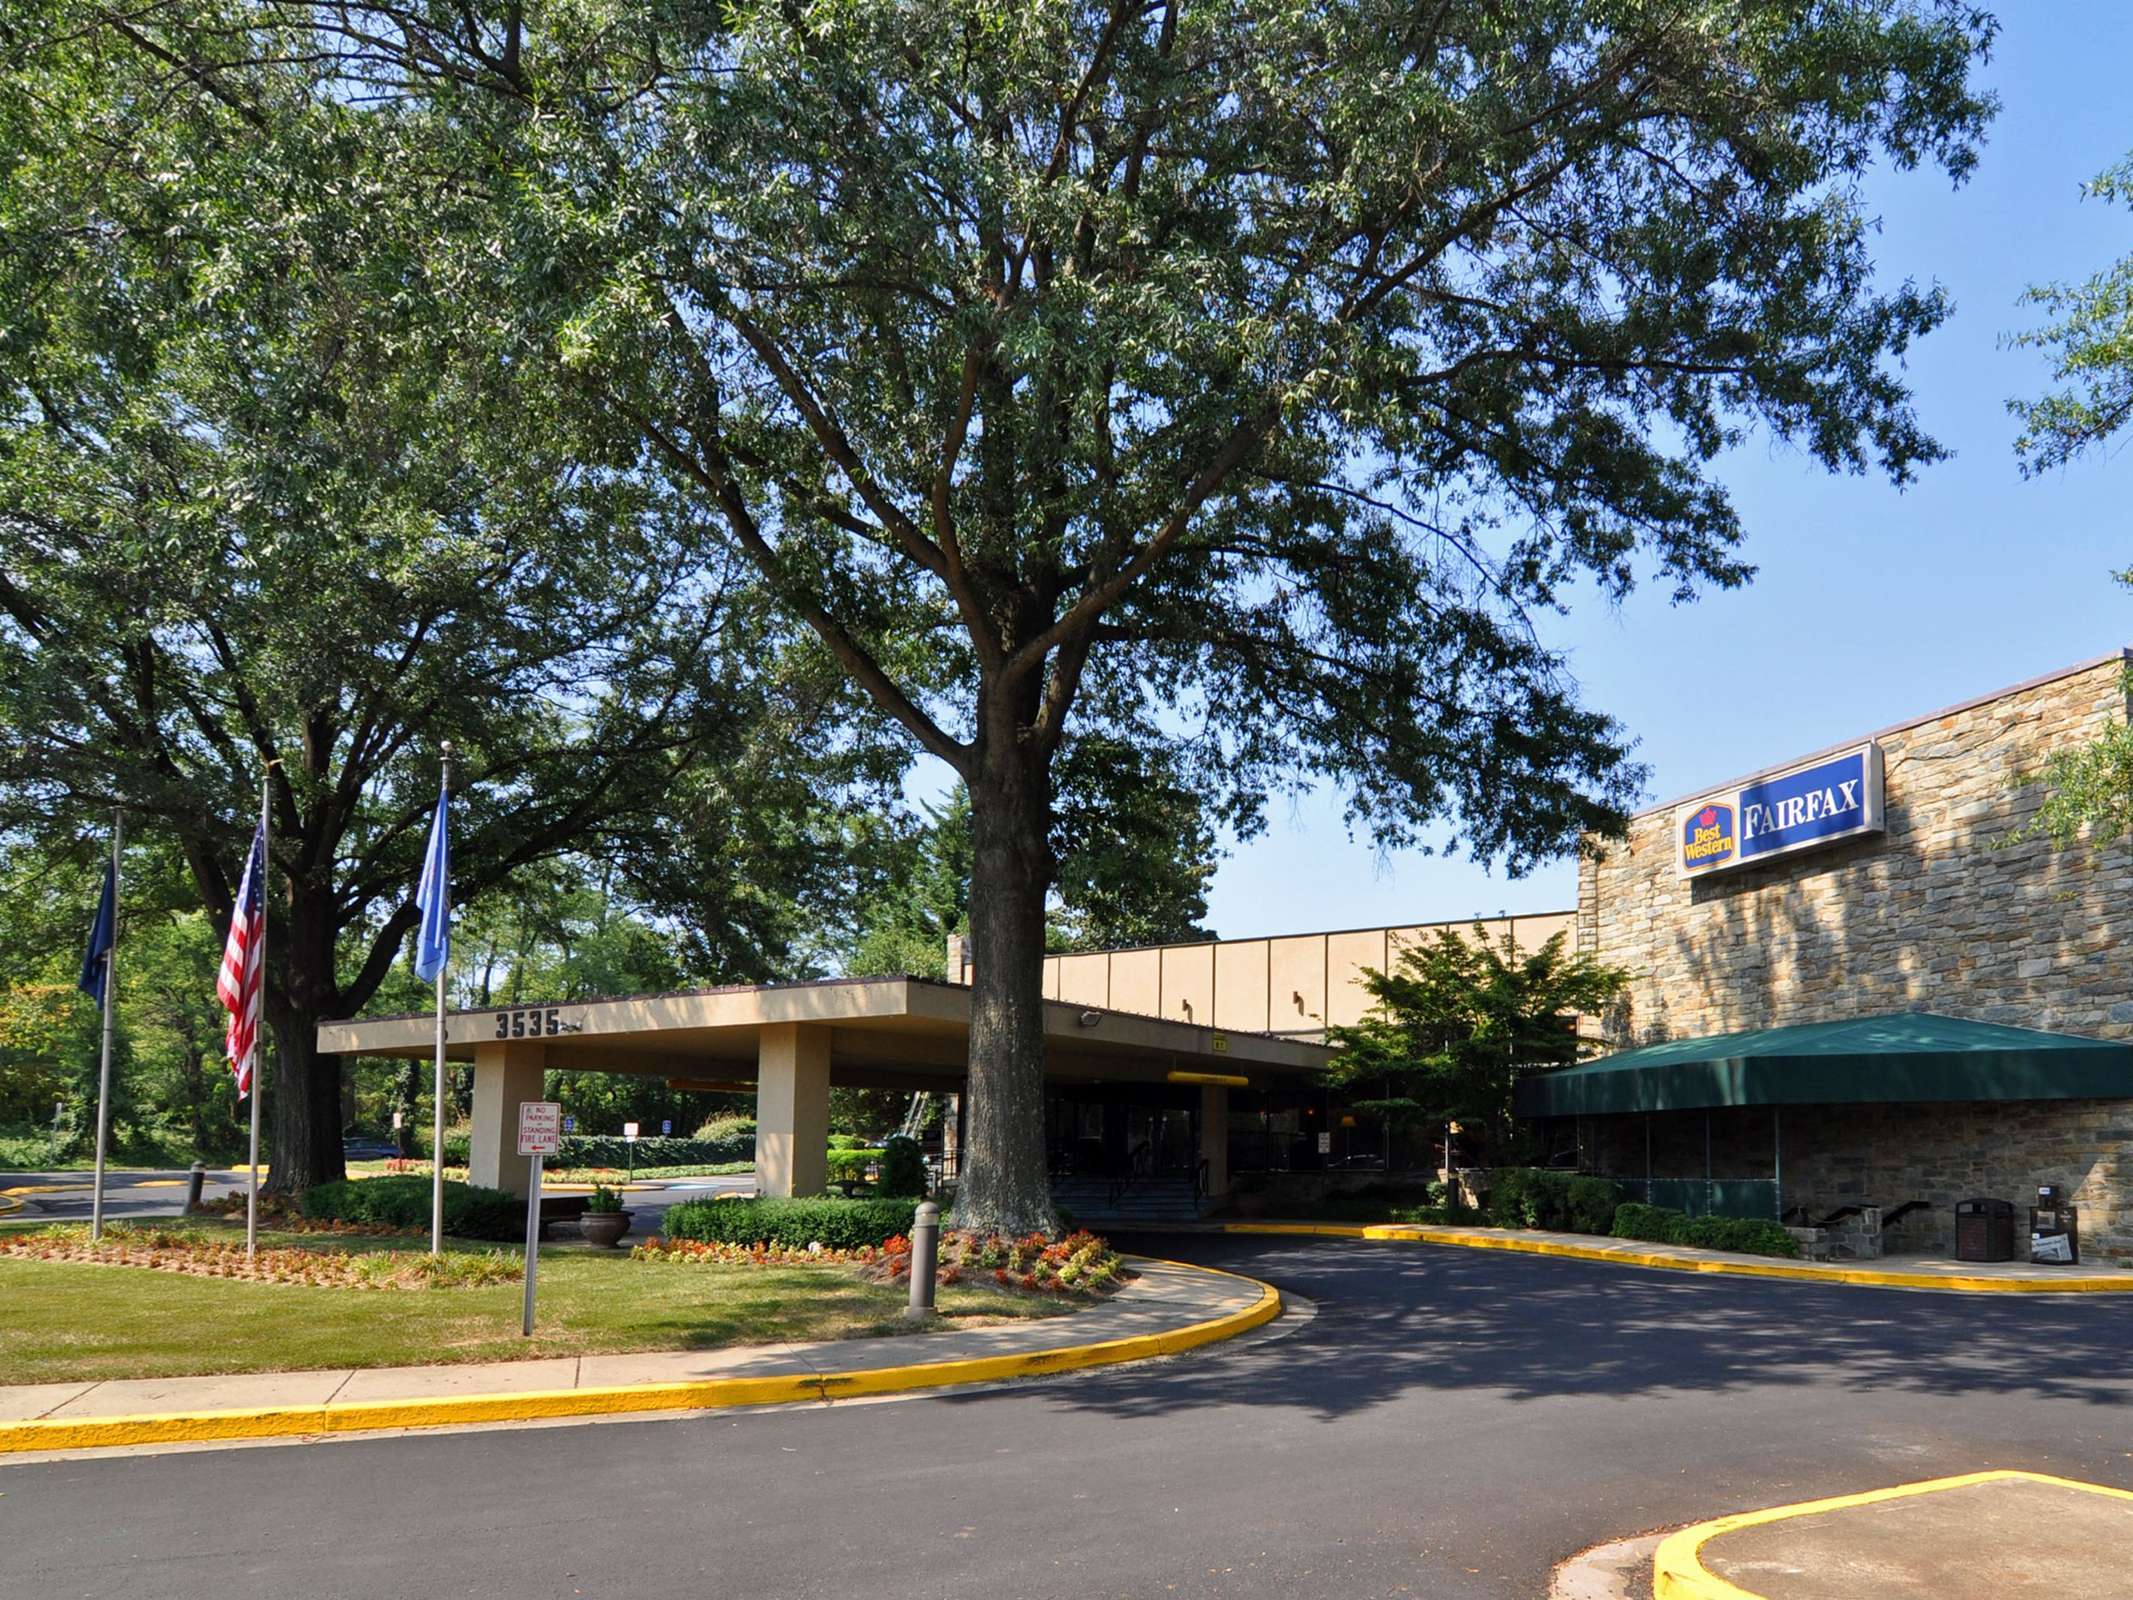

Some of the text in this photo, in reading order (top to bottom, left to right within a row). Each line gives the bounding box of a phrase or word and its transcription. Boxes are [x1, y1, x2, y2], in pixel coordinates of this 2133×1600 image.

[1743, 779, 1859, 840] FAIRFAX
[1694, 823, 1721, 845] Best
[1685, 837, 1732, 860] Western
[495, 1009, 559, 1039] 3535
[520, 1134, 556, 1144] FIRE LANE
[522, 1126, 556, 1134] STANDING
